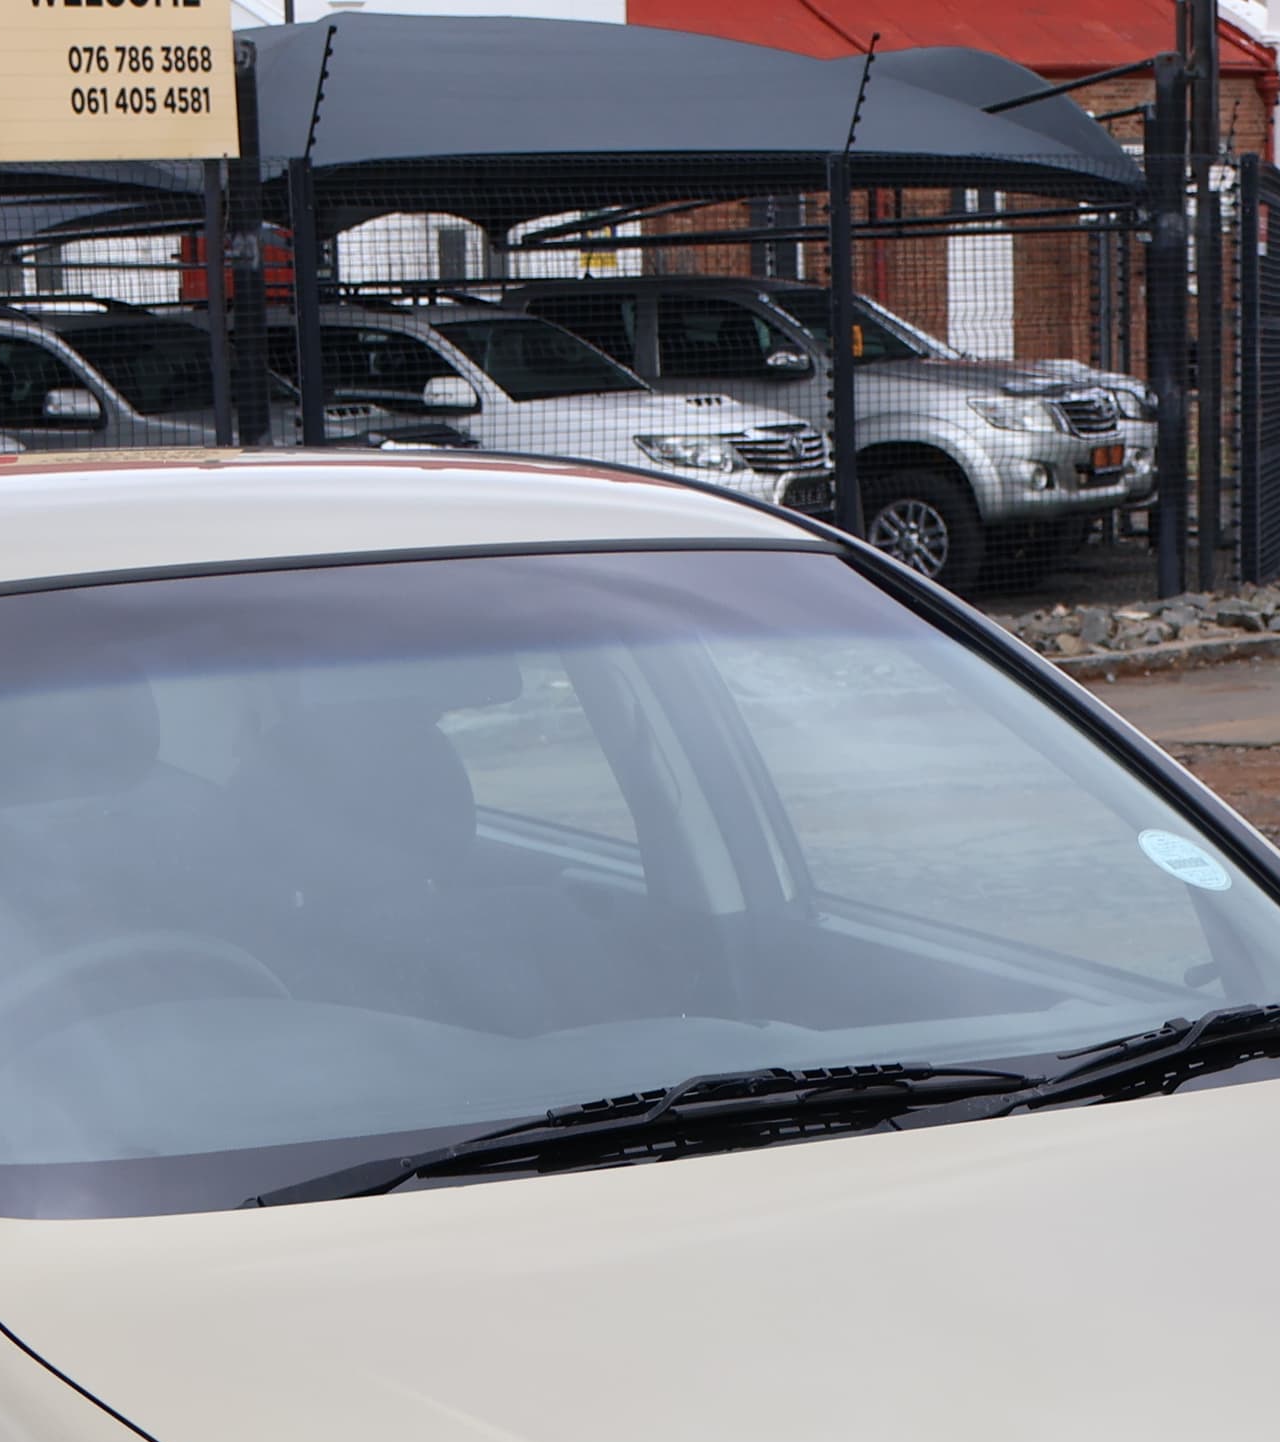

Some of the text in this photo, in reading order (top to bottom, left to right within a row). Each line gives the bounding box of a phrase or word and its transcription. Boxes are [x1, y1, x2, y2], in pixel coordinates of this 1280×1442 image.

[68, 46, 212, 73] 076 786 3868
[71, 87, 211, 114] 061 405 4581
